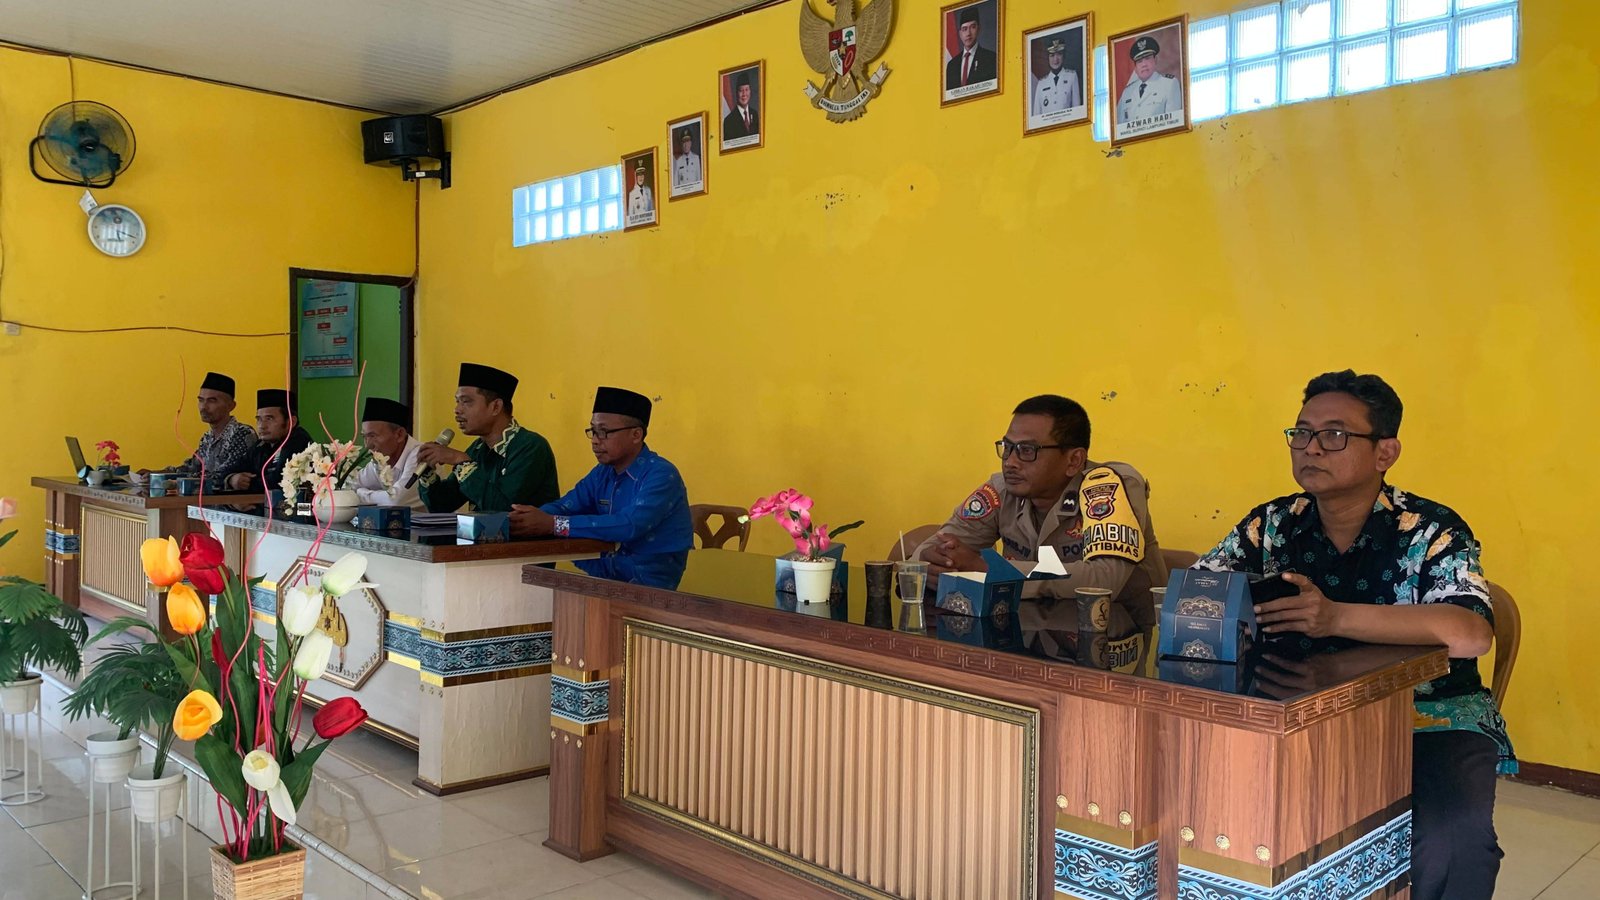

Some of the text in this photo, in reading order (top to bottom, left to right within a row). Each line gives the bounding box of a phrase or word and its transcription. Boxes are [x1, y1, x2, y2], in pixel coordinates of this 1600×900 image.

[1126, 113, 1172, 129] AZWAR HADI
[1062, 543, 1083, 557] PO
